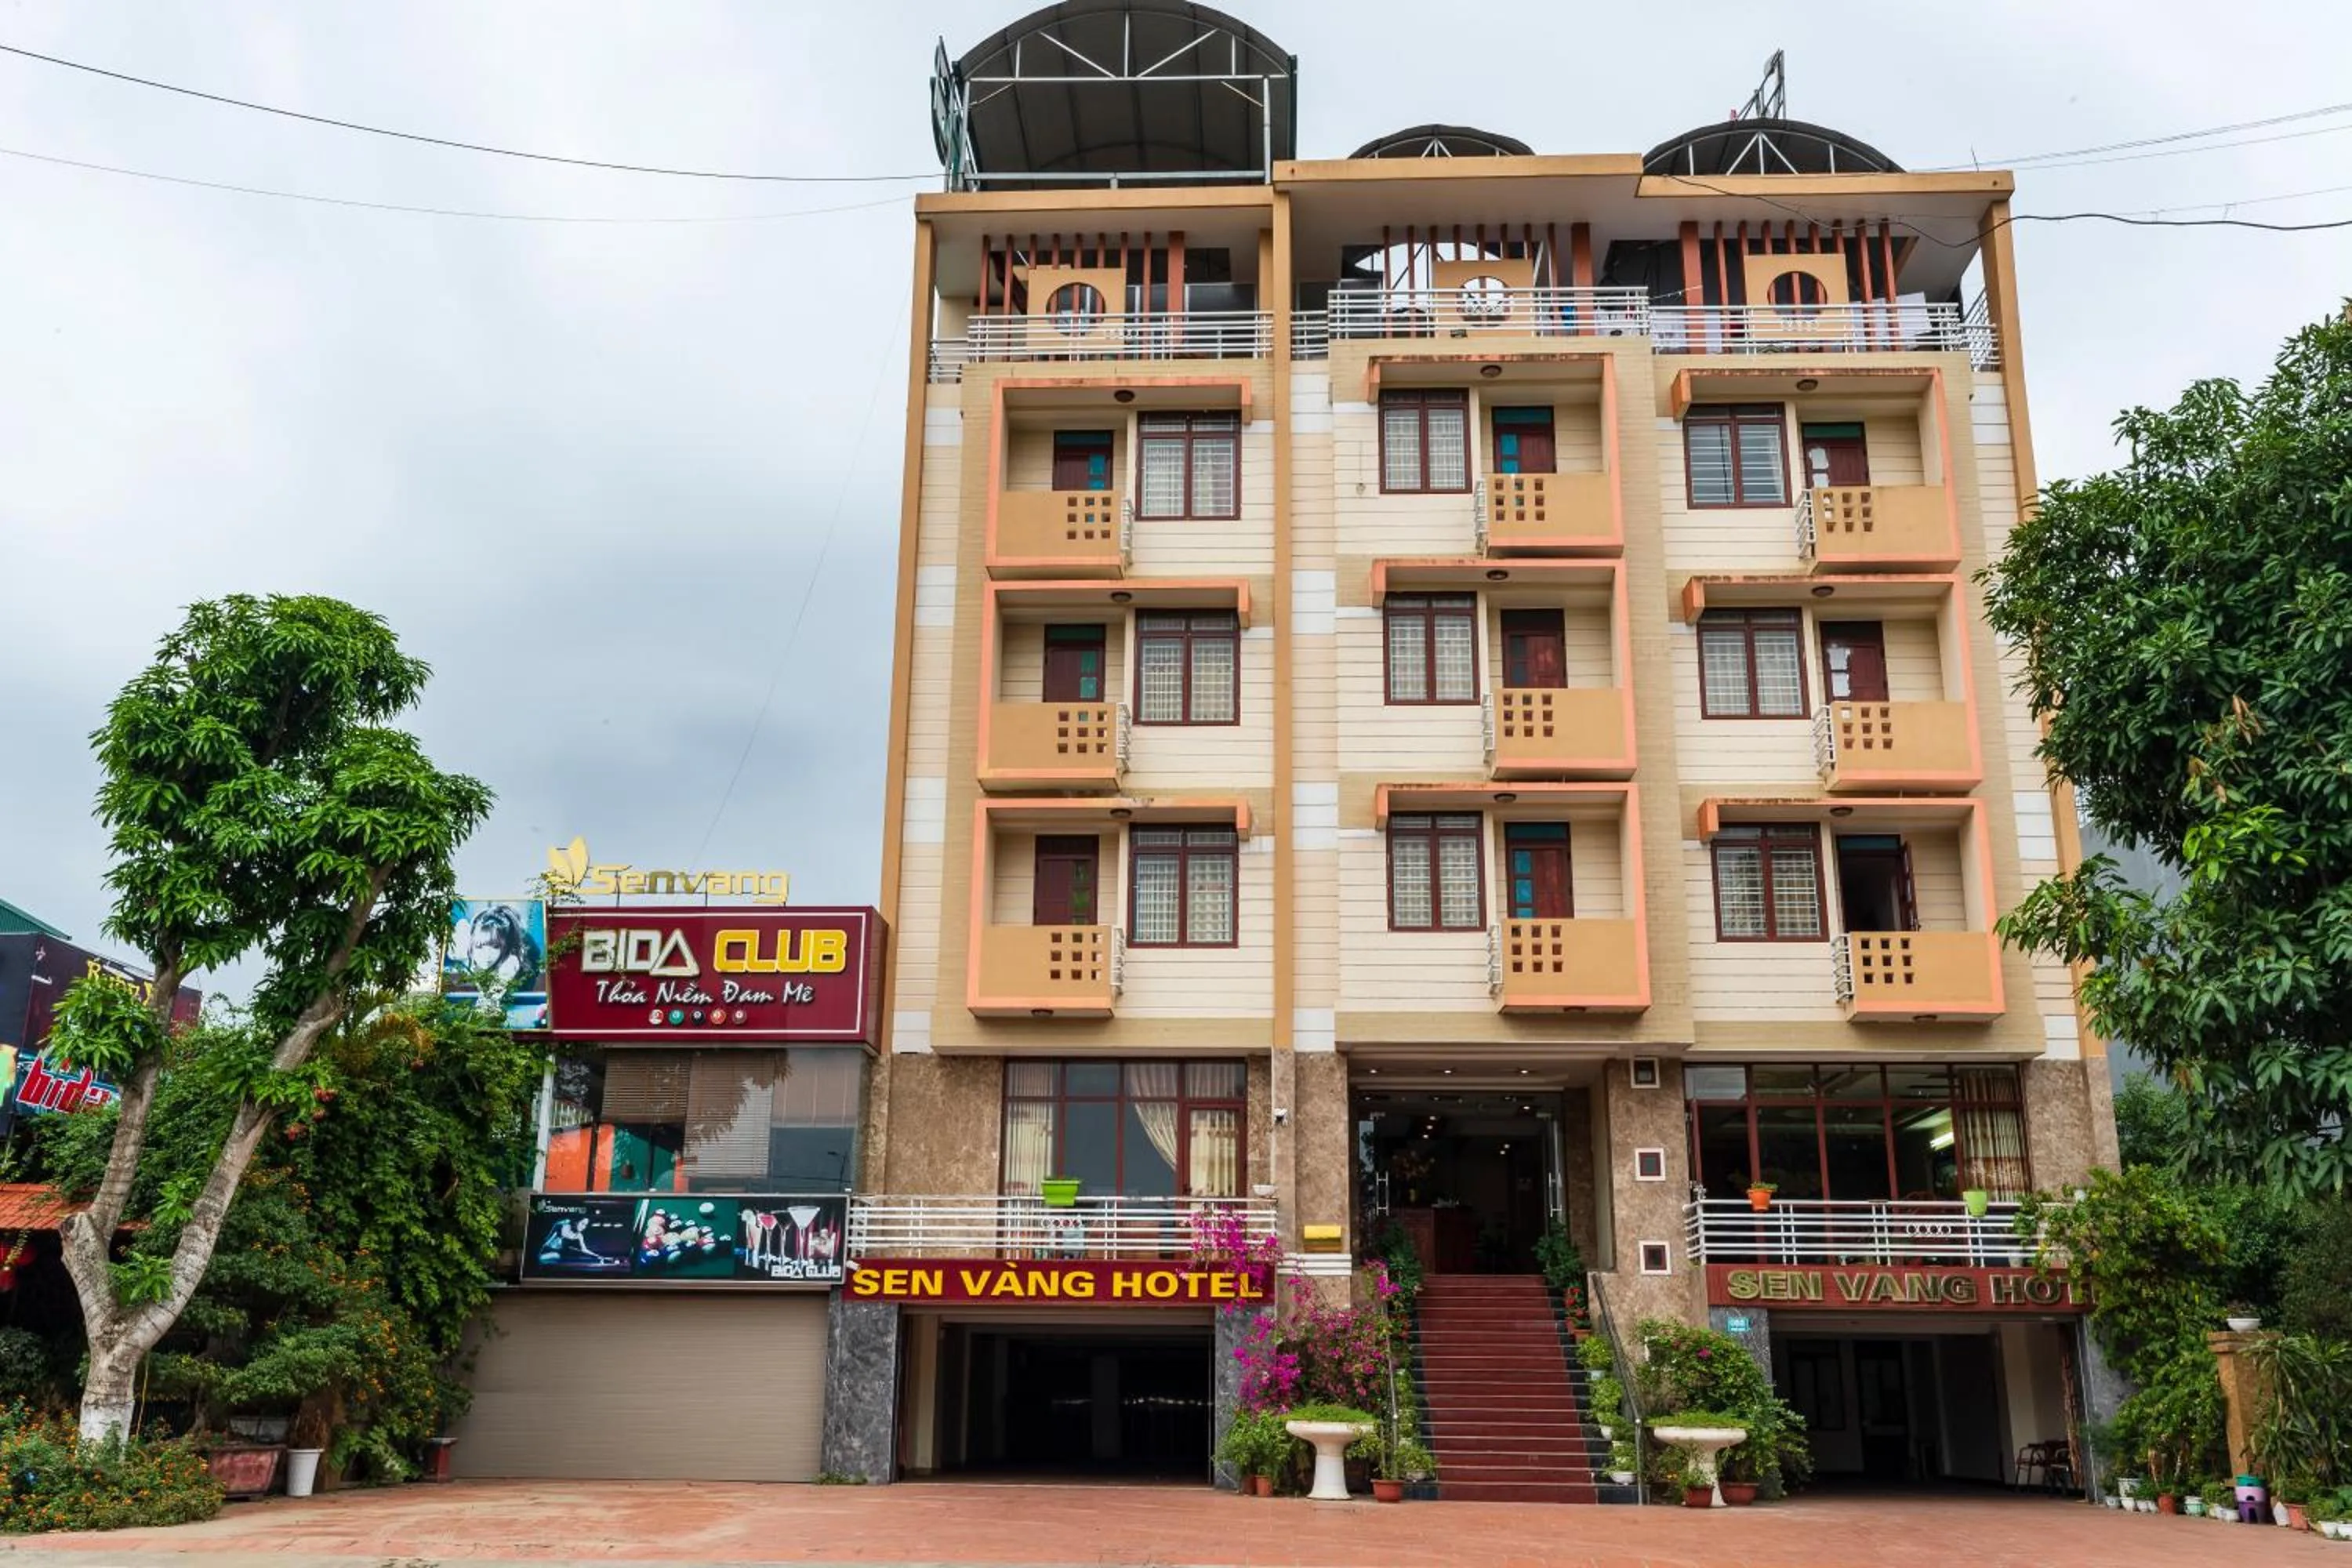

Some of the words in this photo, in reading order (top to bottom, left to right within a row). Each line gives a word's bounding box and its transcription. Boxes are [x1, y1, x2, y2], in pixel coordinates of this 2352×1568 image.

[581, 927, 700, 977] BIDA
[713, 929, 848, 974] CLUB
[720, 979, 775, 1004] Đam
[782, 981, 815, 1004] Mê
[805, 1265, 841, 1277] CLUB
[852, 1269, 942, 1297] SEN
[960, 1262, 1095, 1298] VÀNG
[1112, 1271, 1263, 1298] HOTEL
[1727, 1269, 1824, 1301] SEN
[1833, 1272, 1978, 1304] VANG
